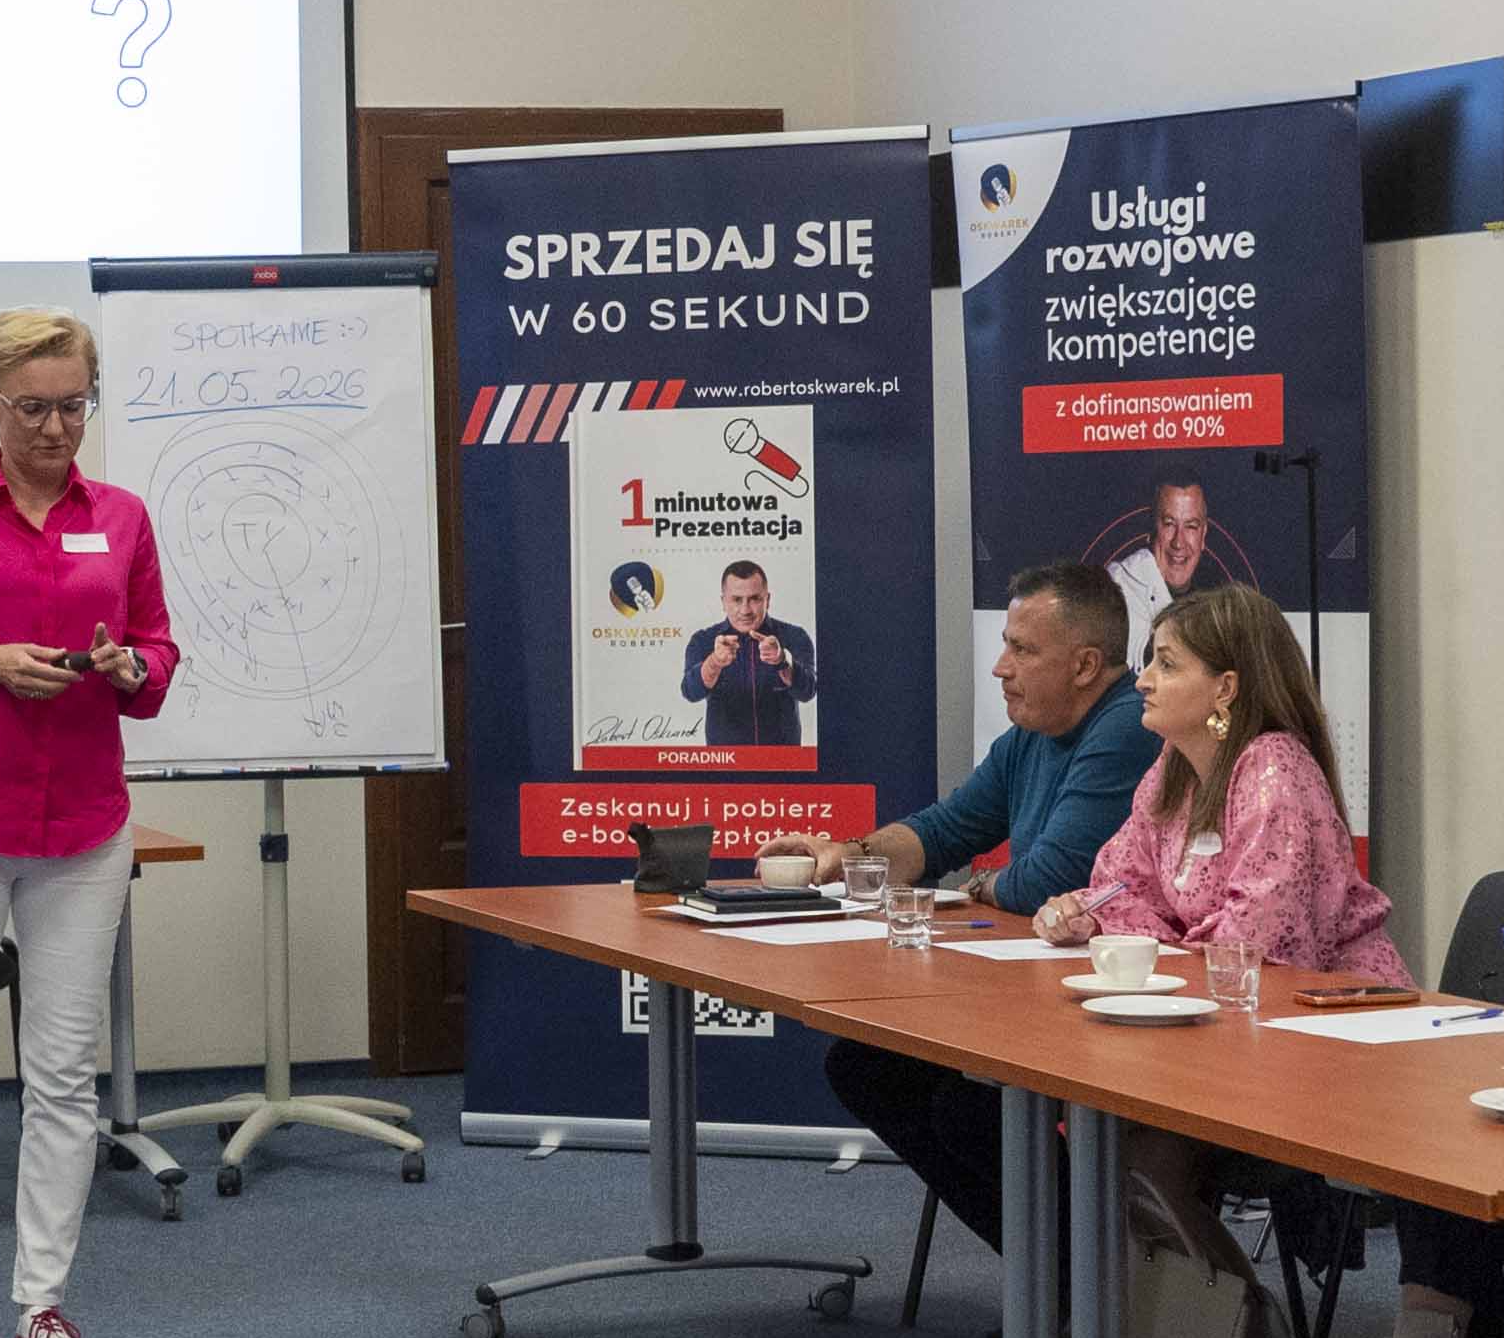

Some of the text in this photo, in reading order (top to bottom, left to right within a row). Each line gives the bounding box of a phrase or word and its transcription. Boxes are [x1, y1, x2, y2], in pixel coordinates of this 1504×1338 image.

[1091, 181, 1206, 236] Usługi
[503, 218, 874, 280] SPRZEDAJ SIĘ
[1046, 226, 1256, 277] rozwojowe
[508, 291, 871, 336] W 60 SEKUND
[1045, 276, 1257, 328] zwiększające
[1047, 316, 1256, 368] kompetencje
[276, 365, 367, 401] 2026
[694, 376, 900, 399] www.robertoskwarek.pl
[1055, 387, 1254, 418] z dofinansowaniem
[1083, 415, 1225, 442] nawet do 90%
[621, 478, 654, 527] 1
[654, 491, 779, 513] minutowa
[654, 514, 803, 540] Prezentacja
[591, 627, 683, 638] OSKWAREK
[657, 751, 736, 764] PORADNIK
[560, 797, 833, 821] Zeskanuj i pobierz
